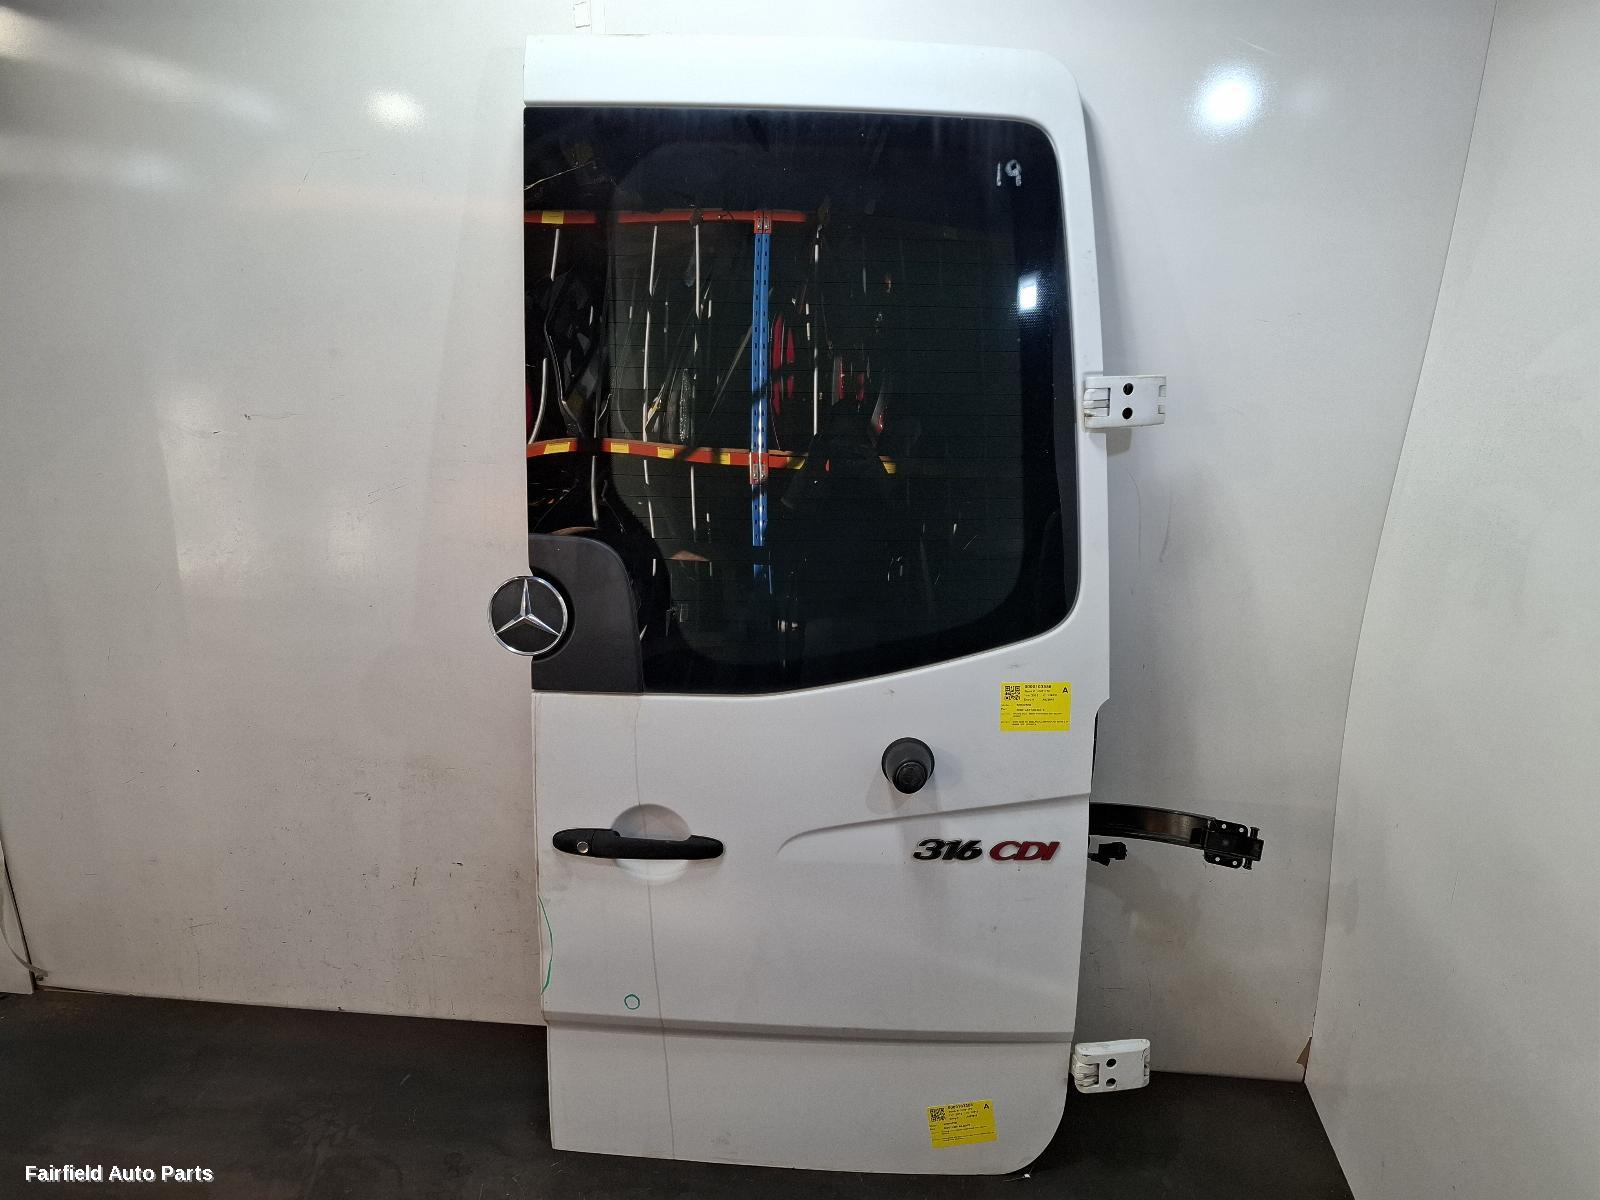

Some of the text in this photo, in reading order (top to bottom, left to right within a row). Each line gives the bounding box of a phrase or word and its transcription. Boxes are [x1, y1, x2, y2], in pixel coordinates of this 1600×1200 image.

[996, 159, 1022, 187] 19
[1062, 686, 1069, 694] A
[912, 838, 1060, 861] 316 CDI
